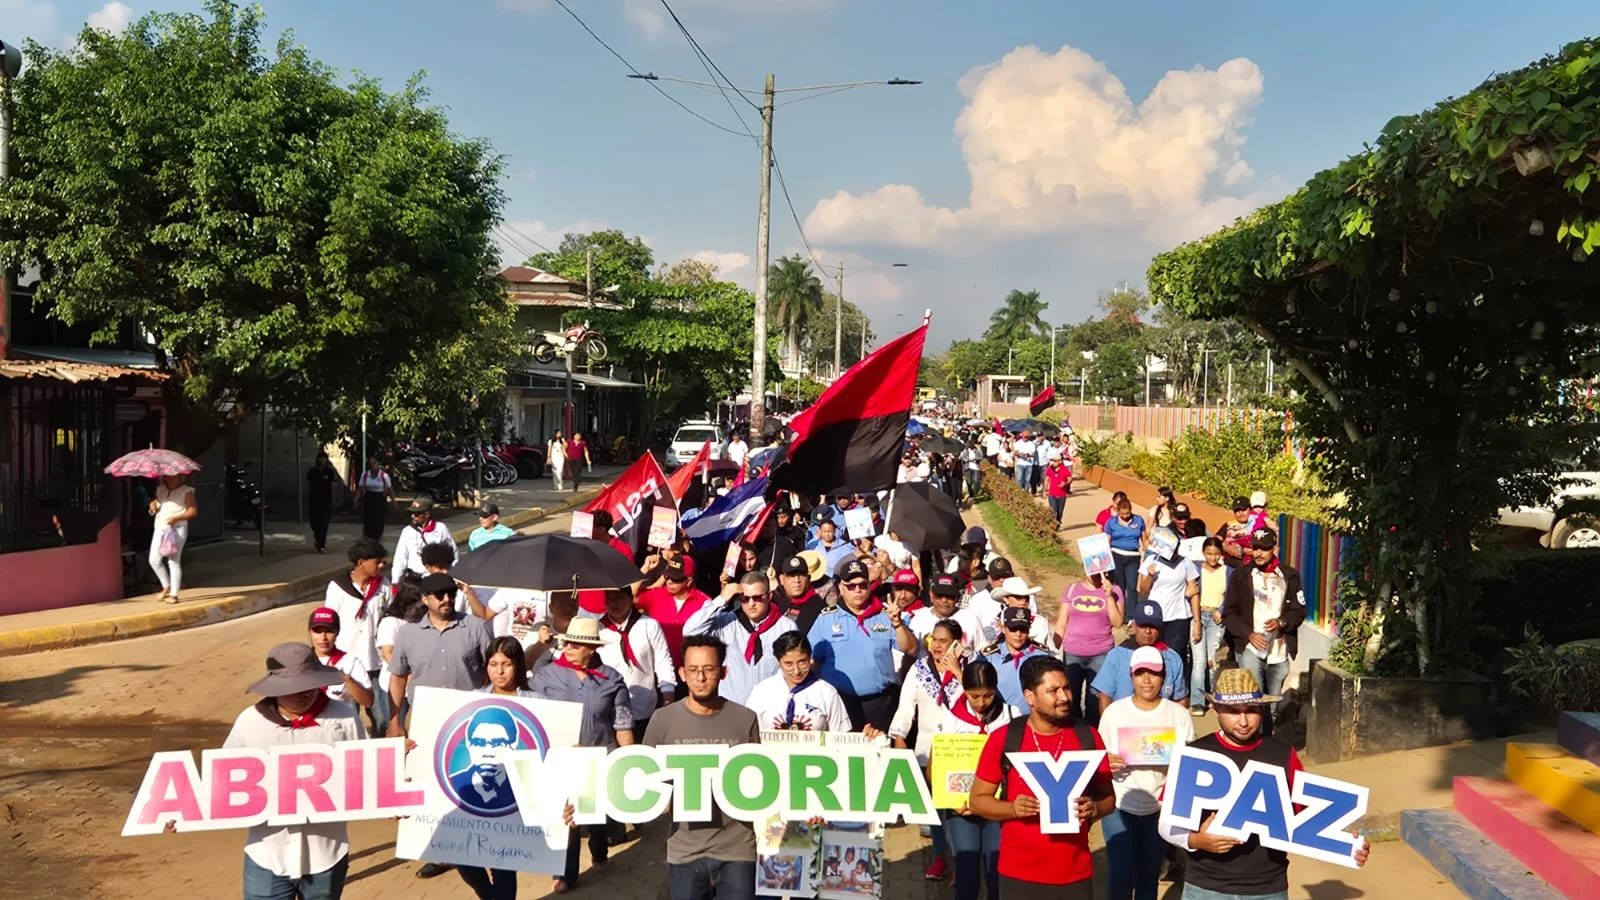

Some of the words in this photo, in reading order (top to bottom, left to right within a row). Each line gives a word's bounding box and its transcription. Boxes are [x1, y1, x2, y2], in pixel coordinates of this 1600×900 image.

[1221, 692, 1254, 701] NICARAGUA
[136, 746, 425, 825] ABRIL
[513, 753, 928, 815] VICTORIA
[1024, 760, 1090, 824] Y
[1171, 754, 1359, 857] PAZ
[415, 814, 490, 831] MOVIMIENTO
[493, 821, 551, 837] CULTURAL
[477, 833, 534, 860] Rugama
